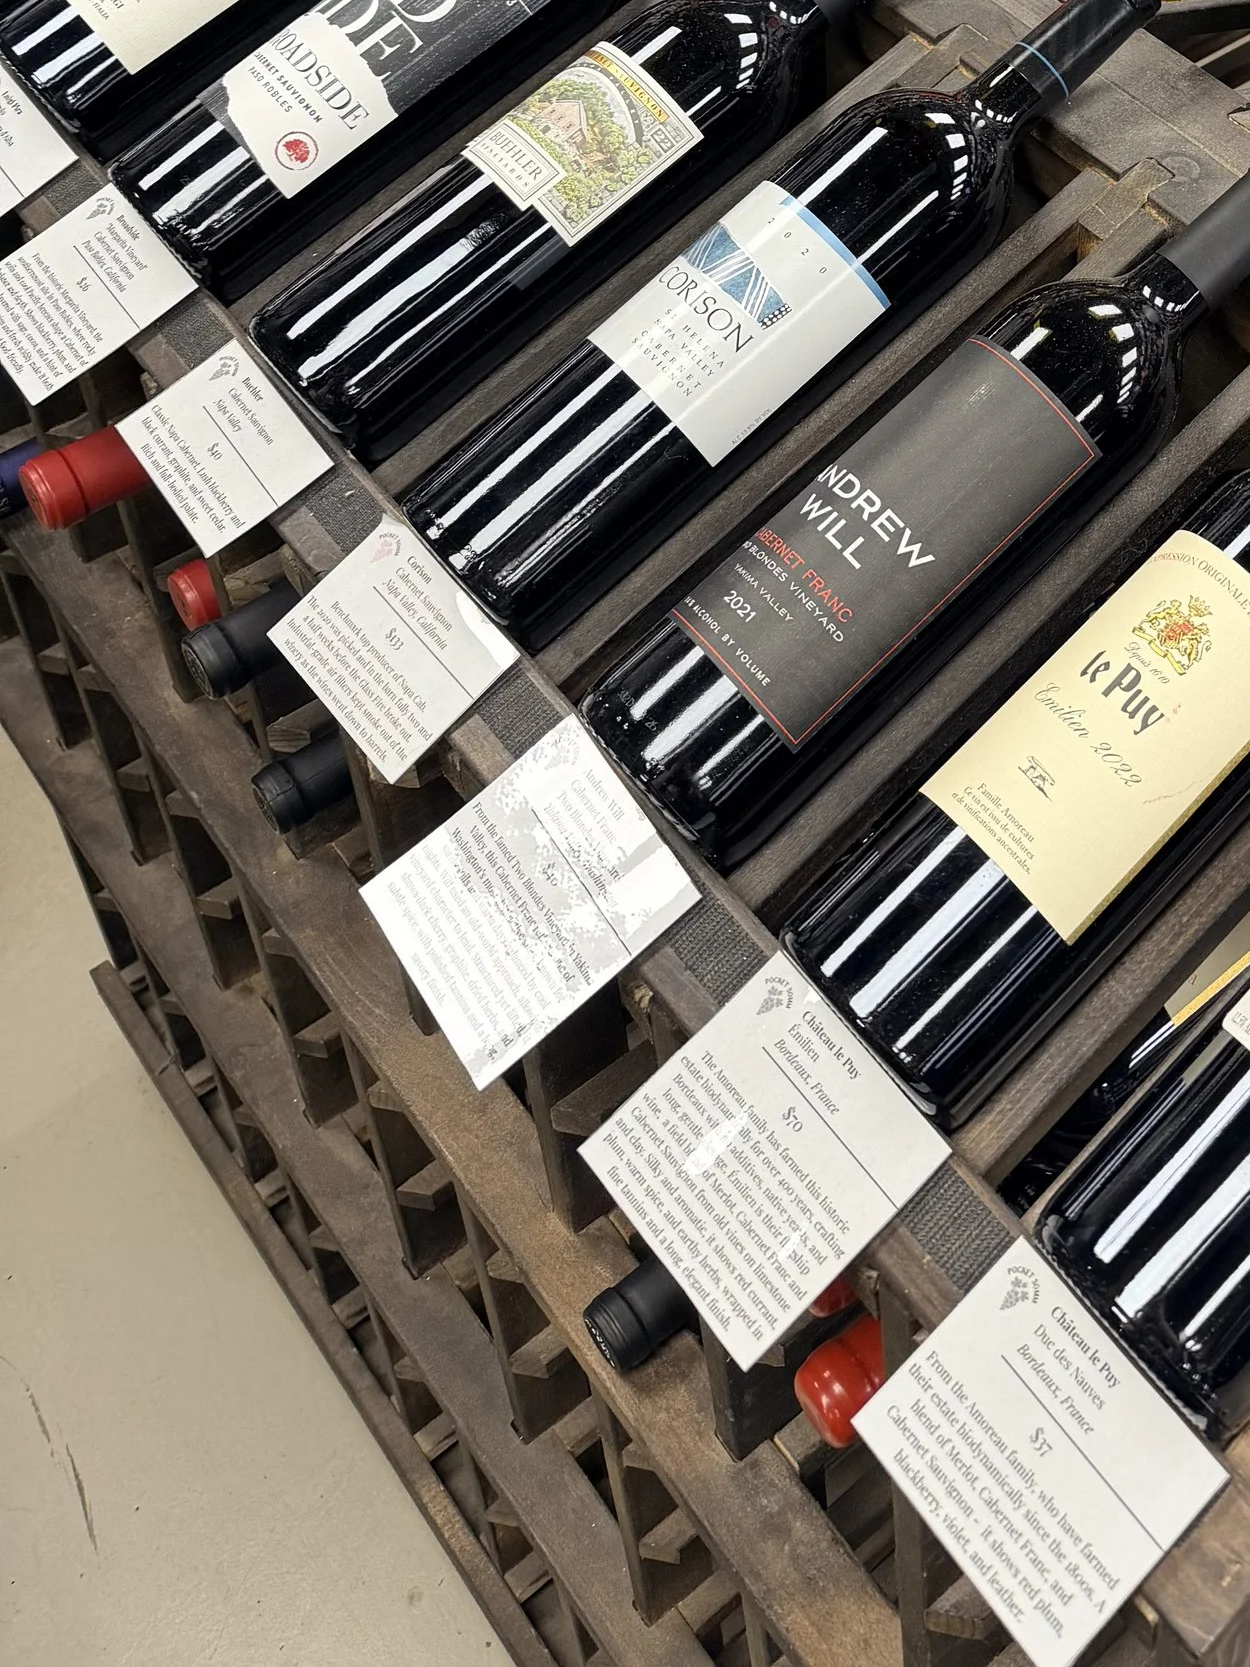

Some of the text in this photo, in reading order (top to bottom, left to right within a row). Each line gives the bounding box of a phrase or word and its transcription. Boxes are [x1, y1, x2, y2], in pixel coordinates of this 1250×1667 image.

[262, 81, 293, 113] ROBLES
[276, 75, 323, 123] SAUVIGNON
[489, 131, 542, 181] BUEHLER
[659, 266, 754, 353] CORISON
[631, 337, 692, 397] SAUVIGNON
[641, 330, 701, 388] CABERNET
[681, 342, 714, 377] VALLEY
[682, 324, 724, 368] HELENA
[213, 398, 242, 432] Napa Valley
[228, 387, 274, 446] Cabernet Sauvignon
[242, 377, 263, 402] Buehler
[800, 493, 864, 570] WILL
[395, 567, 453, 632] Cabernet Sauvignon
[407, 556, 432, 585] Corison
[734, 563, 793, 621] YAKIMA VALLEY
[748, 545, 844, 642] BLONDES VINEYARD
[801, 569, 853, 622] FRANC
[1198, 560, 1250, 610] ORIGINALE
[382, 578, 448, 650] Napa Valley, California
[723, 590, 756, 622] 2021
[385, 628, 404, 651] $133
[692, 604, 771, 686] ALCOHOL BY VOLUME
[1080, 651, 1165, 736] le Puy
[1034, 682, 1142, 787] Emilien 2022
[977, 782, 1034, 843] Famille Amoreau
[472, 801, 546, 911] From the famed Two Blondes
[788, 1023, 820, 1063] Émilien
[802, 1011, 861, 1080] Château le Puy
[774, 1038, 840, 1115] Bordeaux, France
[782, 1107, 803, 1132] $70
[1033, 1324, 1105, 1410] Duc des Nauves
[1051, 1306, 1120, 1388] Château le Puy
[1016, 1343, 1094, 1435] Bordeaux, France
[926, 1350, 1120, 1591] From the Amoreau family, who have farmed
[1029, 1427, 1053, 1457] $37
